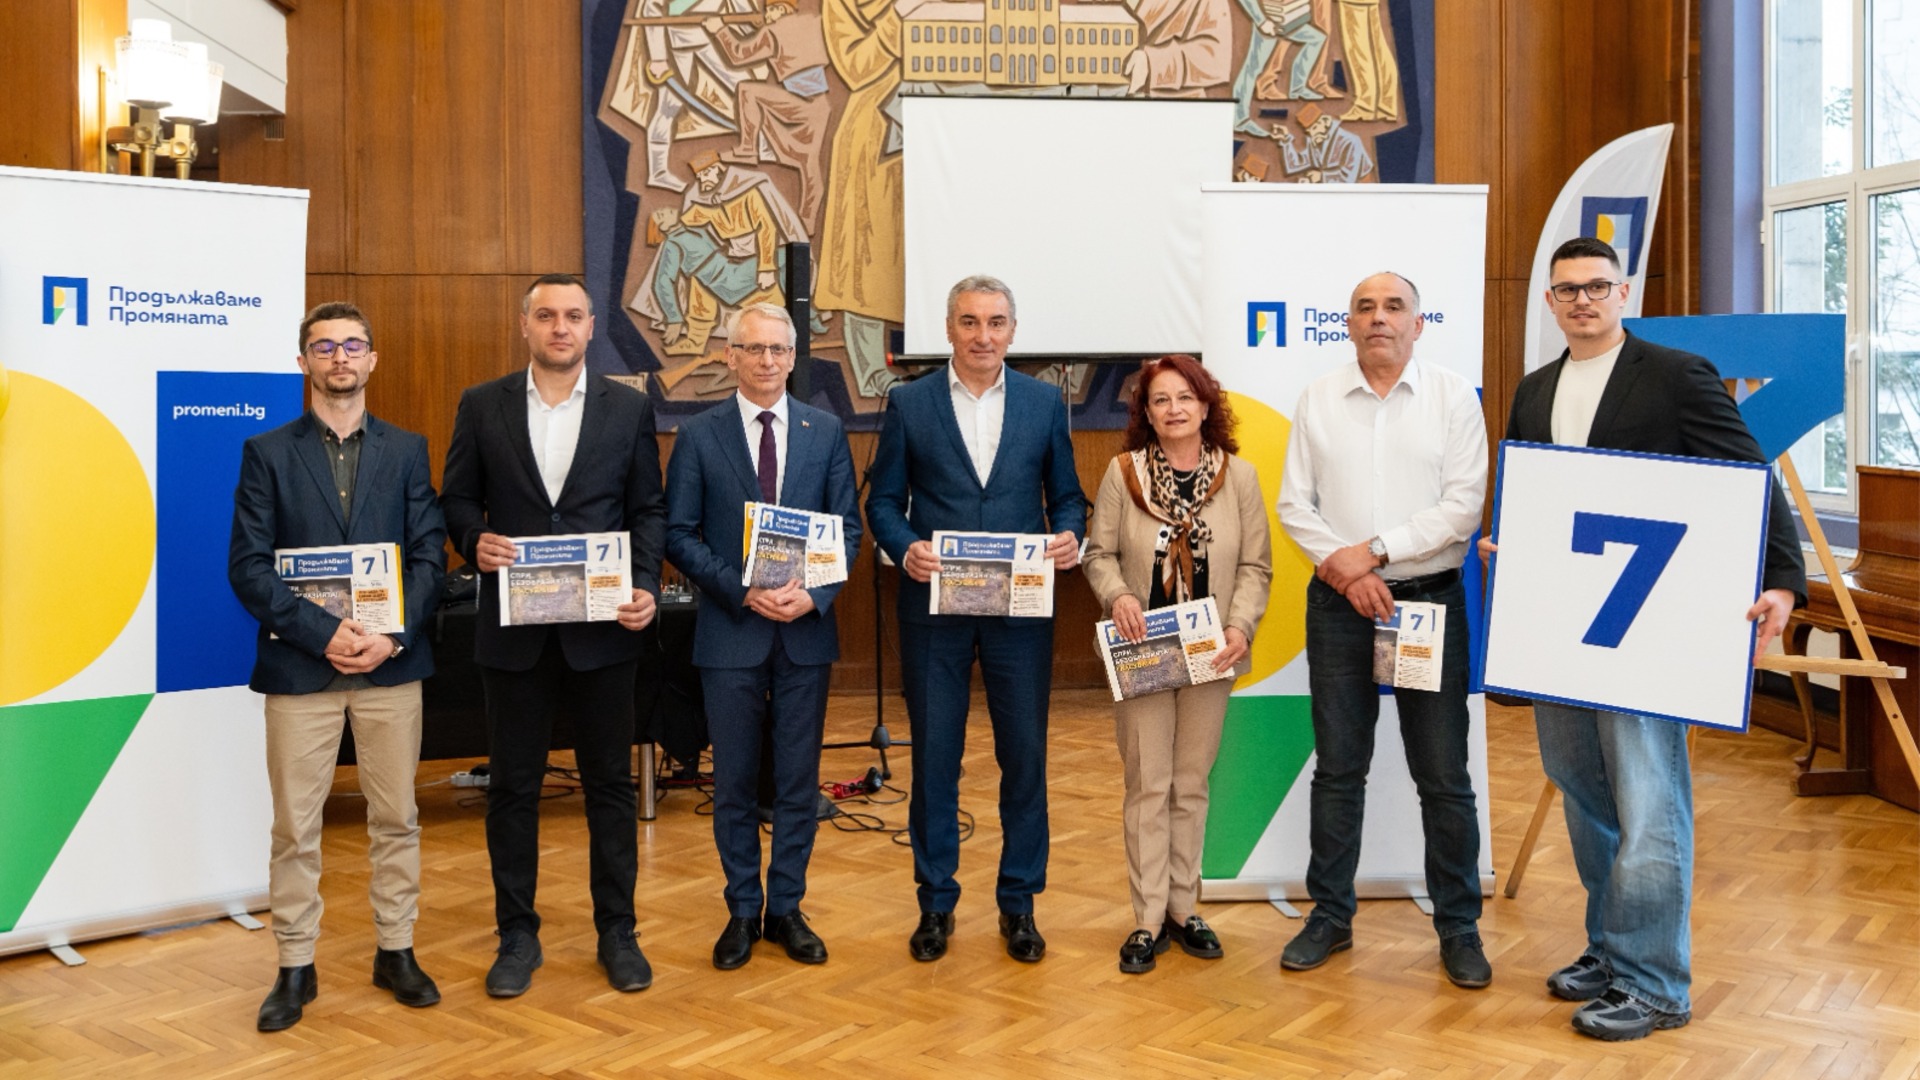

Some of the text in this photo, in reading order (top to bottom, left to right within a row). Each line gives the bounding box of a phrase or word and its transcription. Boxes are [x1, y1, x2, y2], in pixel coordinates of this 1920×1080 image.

[109, 286, 262, 308] Продължаваме
[109, 306, 229, 326] Промяната
[1304, 308, 1444, 327] Продме
[173, 403, 266, 420] promeni.bg
[815, 523, 826, 540] 7
[596, 543, 610, 561] 7
[1023, 544, 1036, 560] 7
[362, 556, 376, 575] 7
[1571, 511, 1688, 649] 7
[1186, 612, 1198, 629] 7
[1410, 613, 1424, 631] 7
